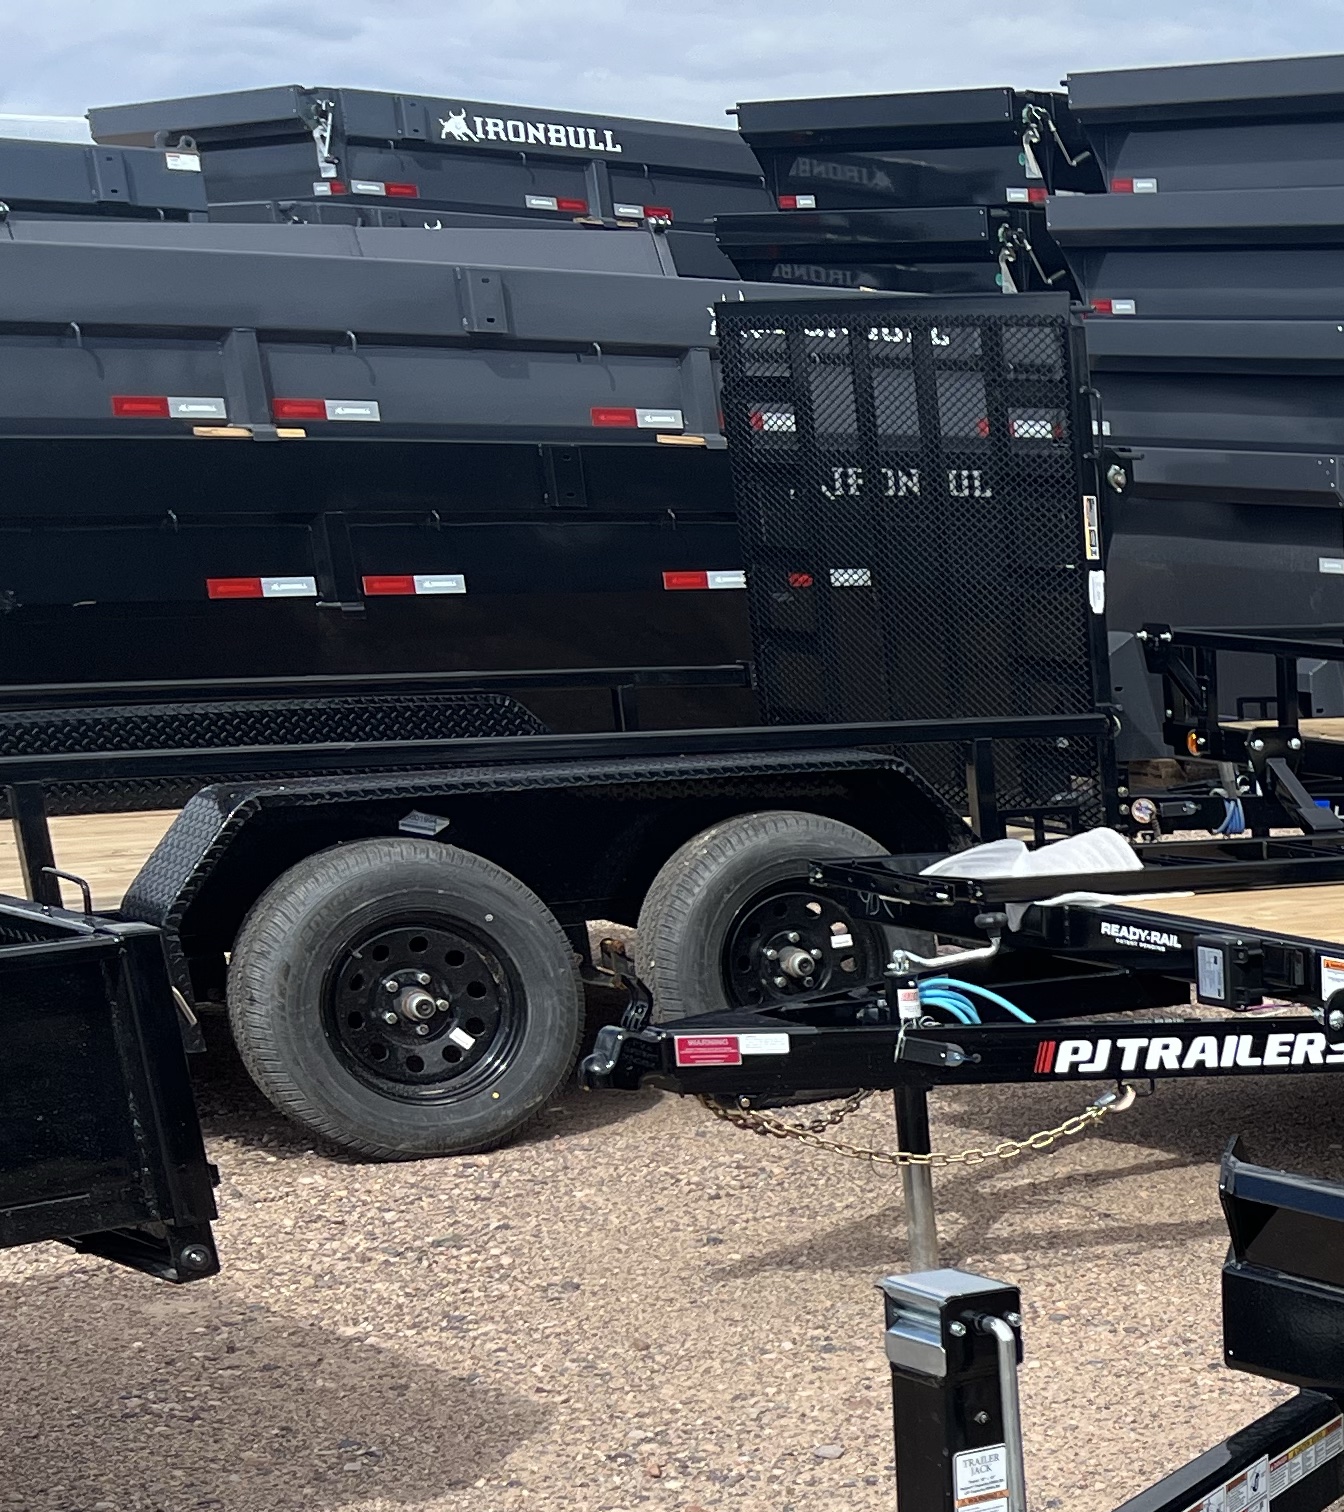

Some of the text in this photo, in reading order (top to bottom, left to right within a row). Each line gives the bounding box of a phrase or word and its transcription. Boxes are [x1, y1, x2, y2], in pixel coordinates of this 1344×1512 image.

[473, 116, 622, 153] IRONBULL
[1054, 1039, 1112, 1074] PJ
[963, 1453, 1000, 1469] TRAILER
[971, 1464, 993, 1476] JACK
